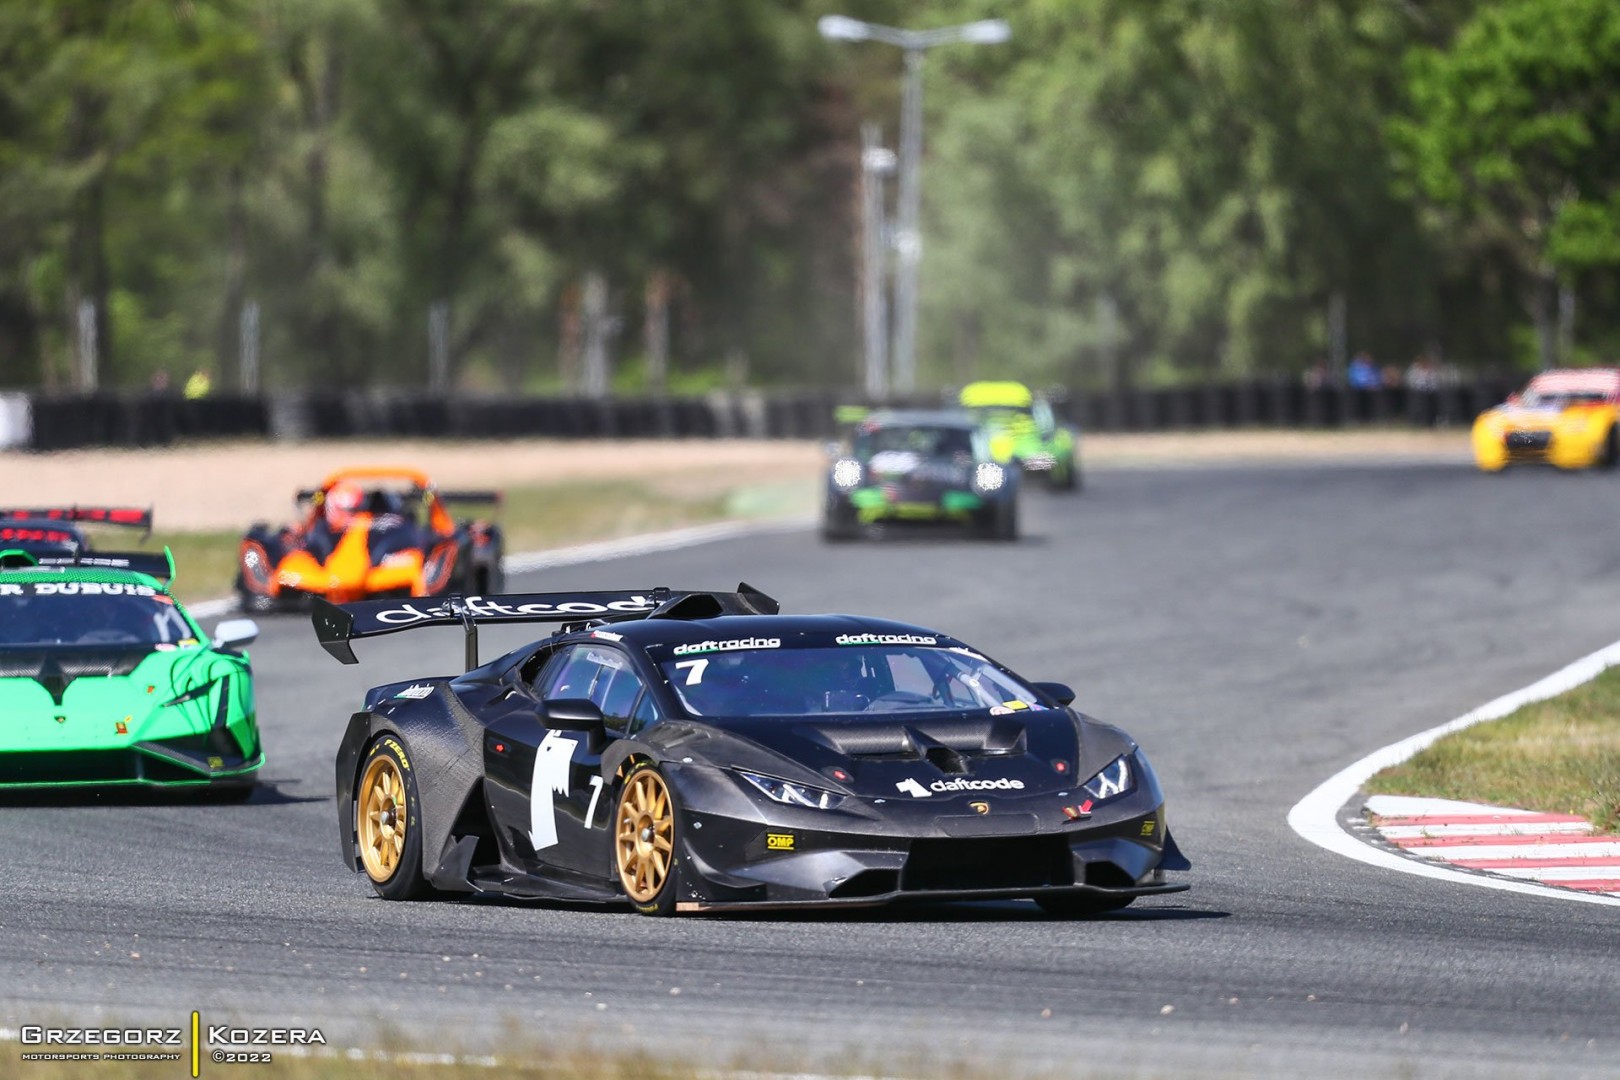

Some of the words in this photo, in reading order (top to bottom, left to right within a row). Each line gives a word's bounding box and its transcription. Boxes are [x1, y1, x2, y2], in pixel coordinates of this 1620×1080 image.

[376, 595, 680, 624] daftcod
[673, 637, 781, 655] daftracing
[835, 633, 937, 645] daftracing
[675, 658, 709, 686] 7
[930, 777, 1025, 792] daftcode
[584, 774, 604, 830] 7
[767, 836, 794, 847] OMP
